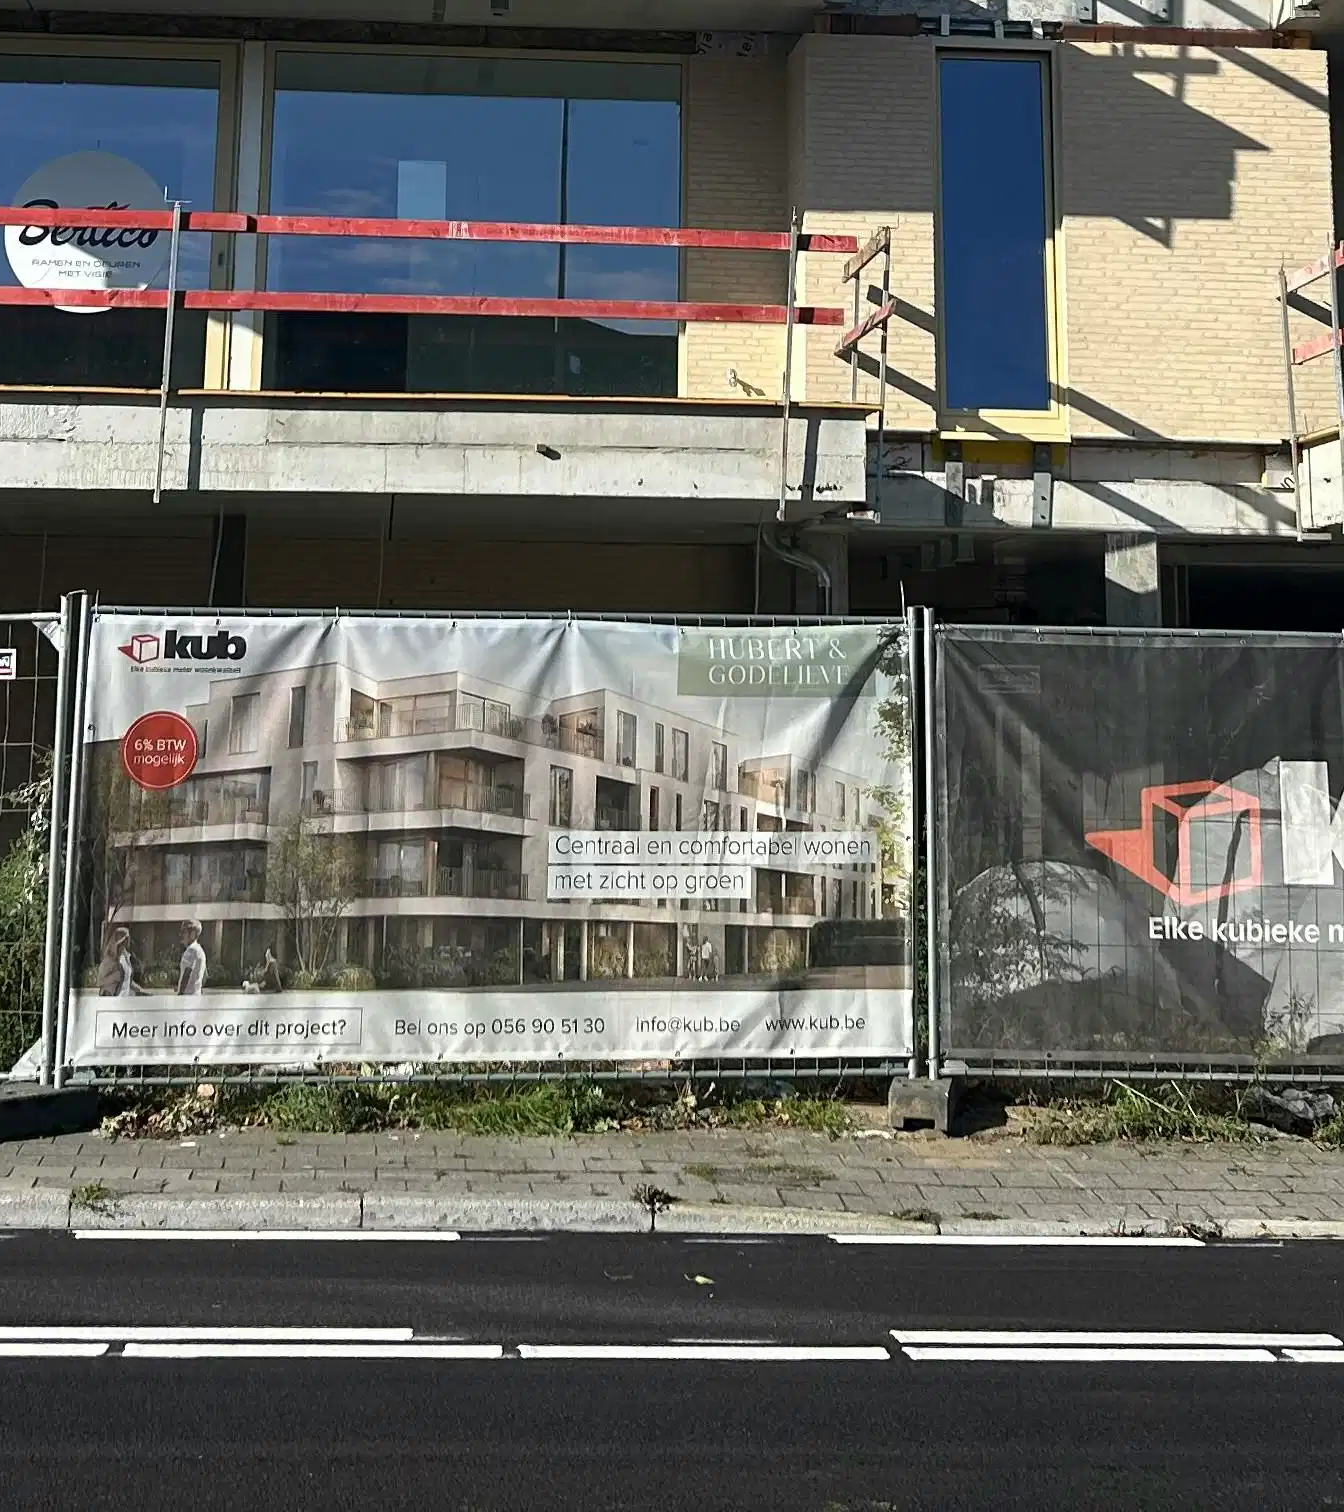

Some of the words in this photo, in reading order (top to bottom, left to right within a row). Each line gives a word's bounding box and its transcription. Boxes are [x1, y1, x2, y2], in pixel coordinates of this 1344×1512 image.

[164, 630, 247, 660] kub
[708, 638, 818, 660] HUBERT
[828, 638, 847, 660] &
[708, 664, 851, 685] GODELIEVE
[134, 739, 154, 751] 6%
[156, 739, 187, 751] BTW
[134, 753, 185, 766] mogelijk
[555, 836, 640, 855] Centraal
[647, 840, 672, 855] en
[679, 835, 797, 855] comfortabel
[803, 839, 871, 854] wonen
[555, 872, 592, 890] met
[599, 870, 646, 890] zicht
[652, 874, 679, 894] op
[684, 874, 745, 894] groen
[1149, 916, 1203, 941] Elke
[1212, 916, 1320, 943] kubieke
[112, 1022, 158, 1038] Meer
[163, 1021, 197, 1038] info
[202, 1023, 243, 1037] over
[247, 1020, 270, 1037] dit
[275, 1019, 346, 1040] project?
[395, 1018, 422, 1035] Bel
[427, 1021, 458, 1035] ons
[463, 1022, 486, 1038] op
[491, 1018, 526, 1035] 056
[531, 1018, 555, 1034] 90
[561, 1018, 578, 1034] 51
[583, 1018, 605, 1034] 30
[635, 1015, 741, 1033] info@kub.be
[765, 1014, 866, 1032] www.kub.be
